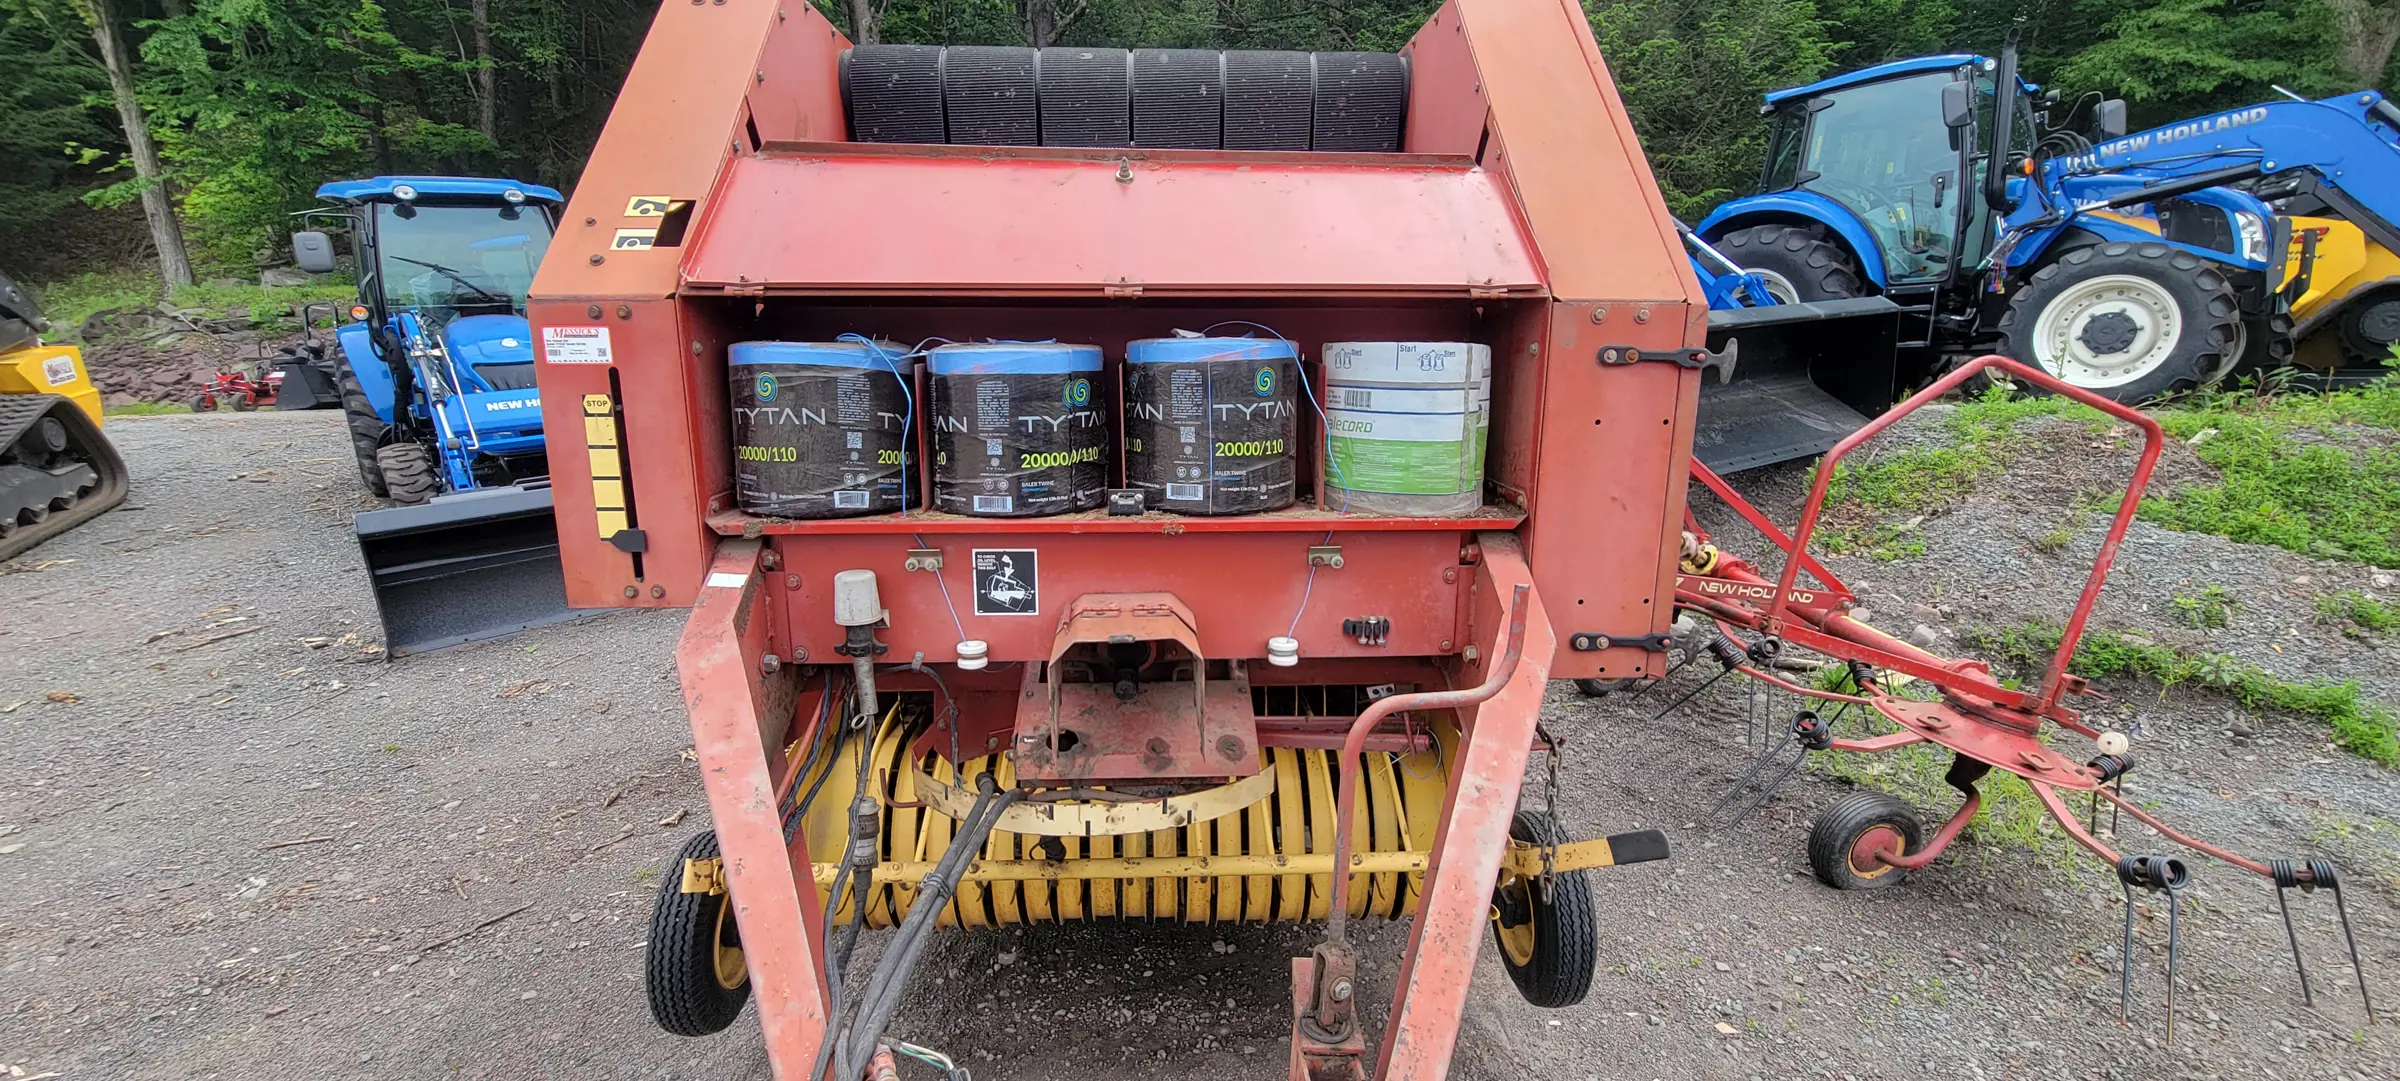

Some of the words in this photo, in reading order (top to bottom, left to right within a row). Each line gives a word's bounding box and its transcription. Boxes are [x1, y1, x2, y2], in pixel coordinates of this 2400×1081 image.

[2101, 134, 2150, 158] NEW
[2156, 107, 2269, 145] HOLLAND
[1400, 344, 1417, 353] Start
[486, 399, 523, 412] NEW
[1212, 399, 1295, 422] TYTAN
[734, 407, 827, 426] TYTAN
[739, 446, 797, 463] 20000/110
[1215, 438, 1284, 457] 20000/110
[1698, 580, 1737, 595] NEW
